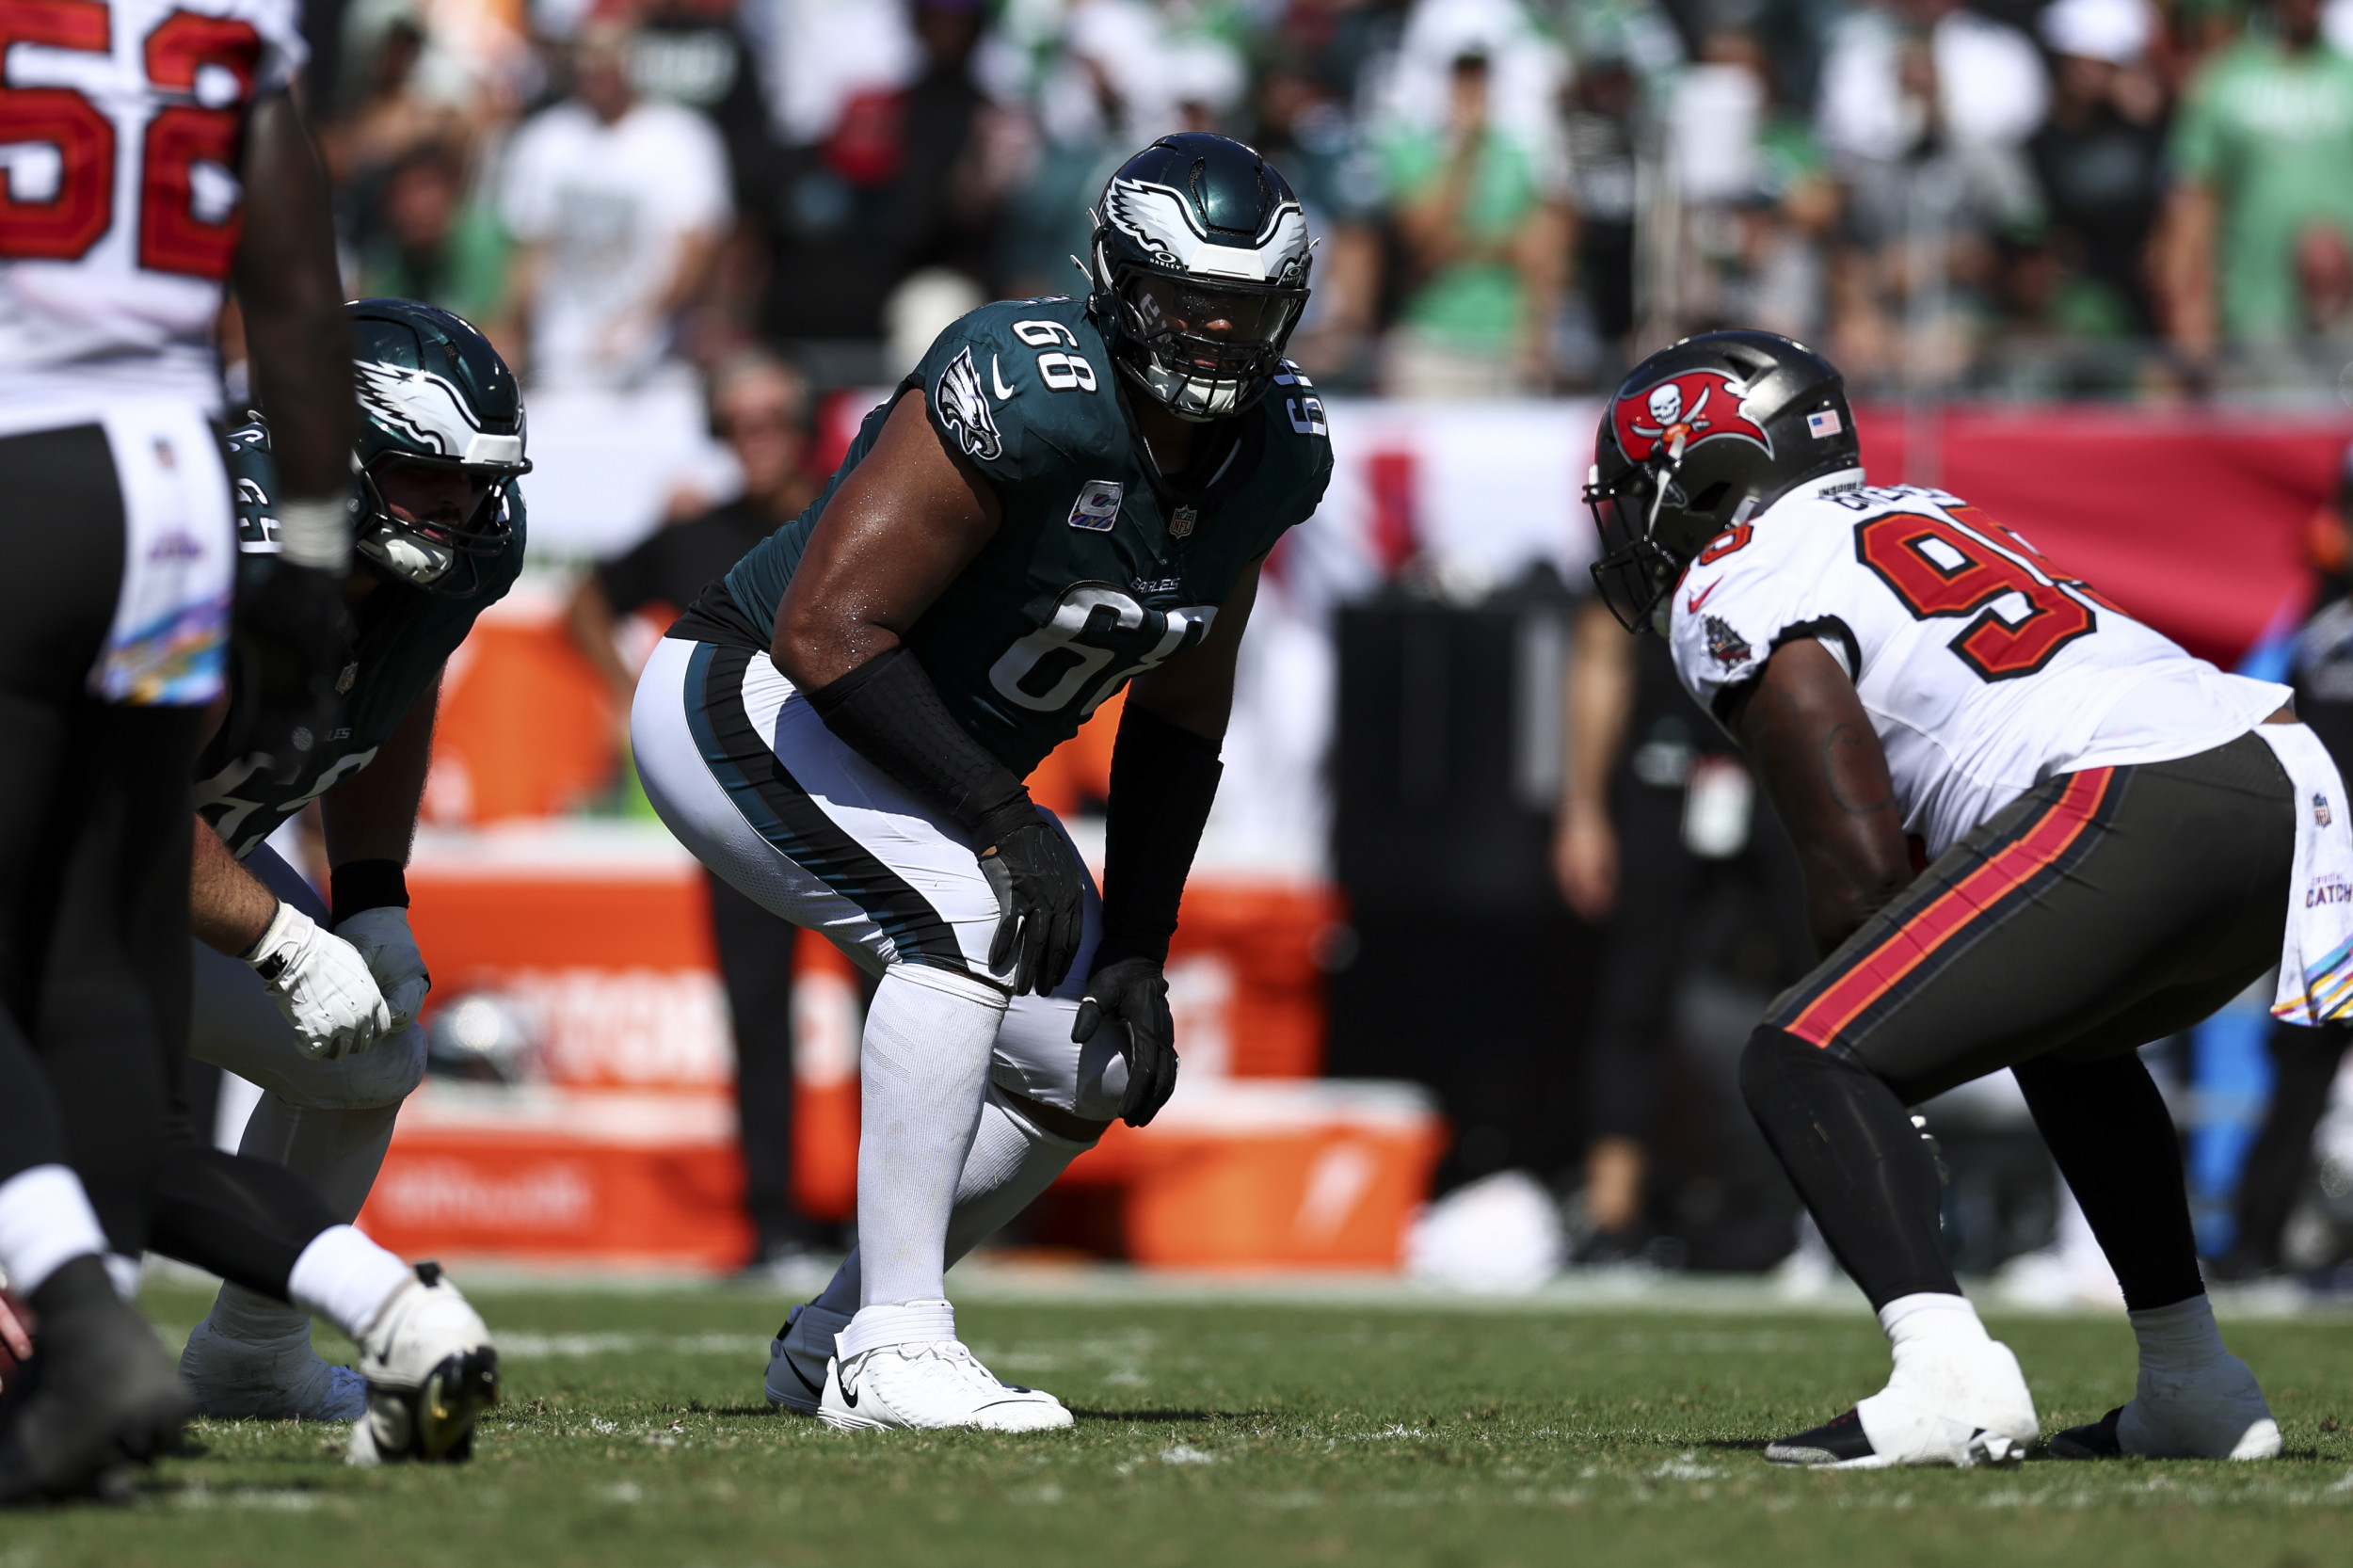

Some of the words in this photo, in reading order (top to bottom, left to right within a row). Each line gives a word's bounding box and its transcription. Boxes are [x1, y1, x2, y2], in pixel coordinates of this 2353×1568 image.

[1149, 257, 1183, 271] OAKLEY
[1010, 319, 1097, 395] 68
[1079, 484, 1120, 518] C
[1173, 520, 1190, 534] NFL
[1130, 576, 1180, 594] EAGLES
[2306, 883, 2352, 909] CATCH
